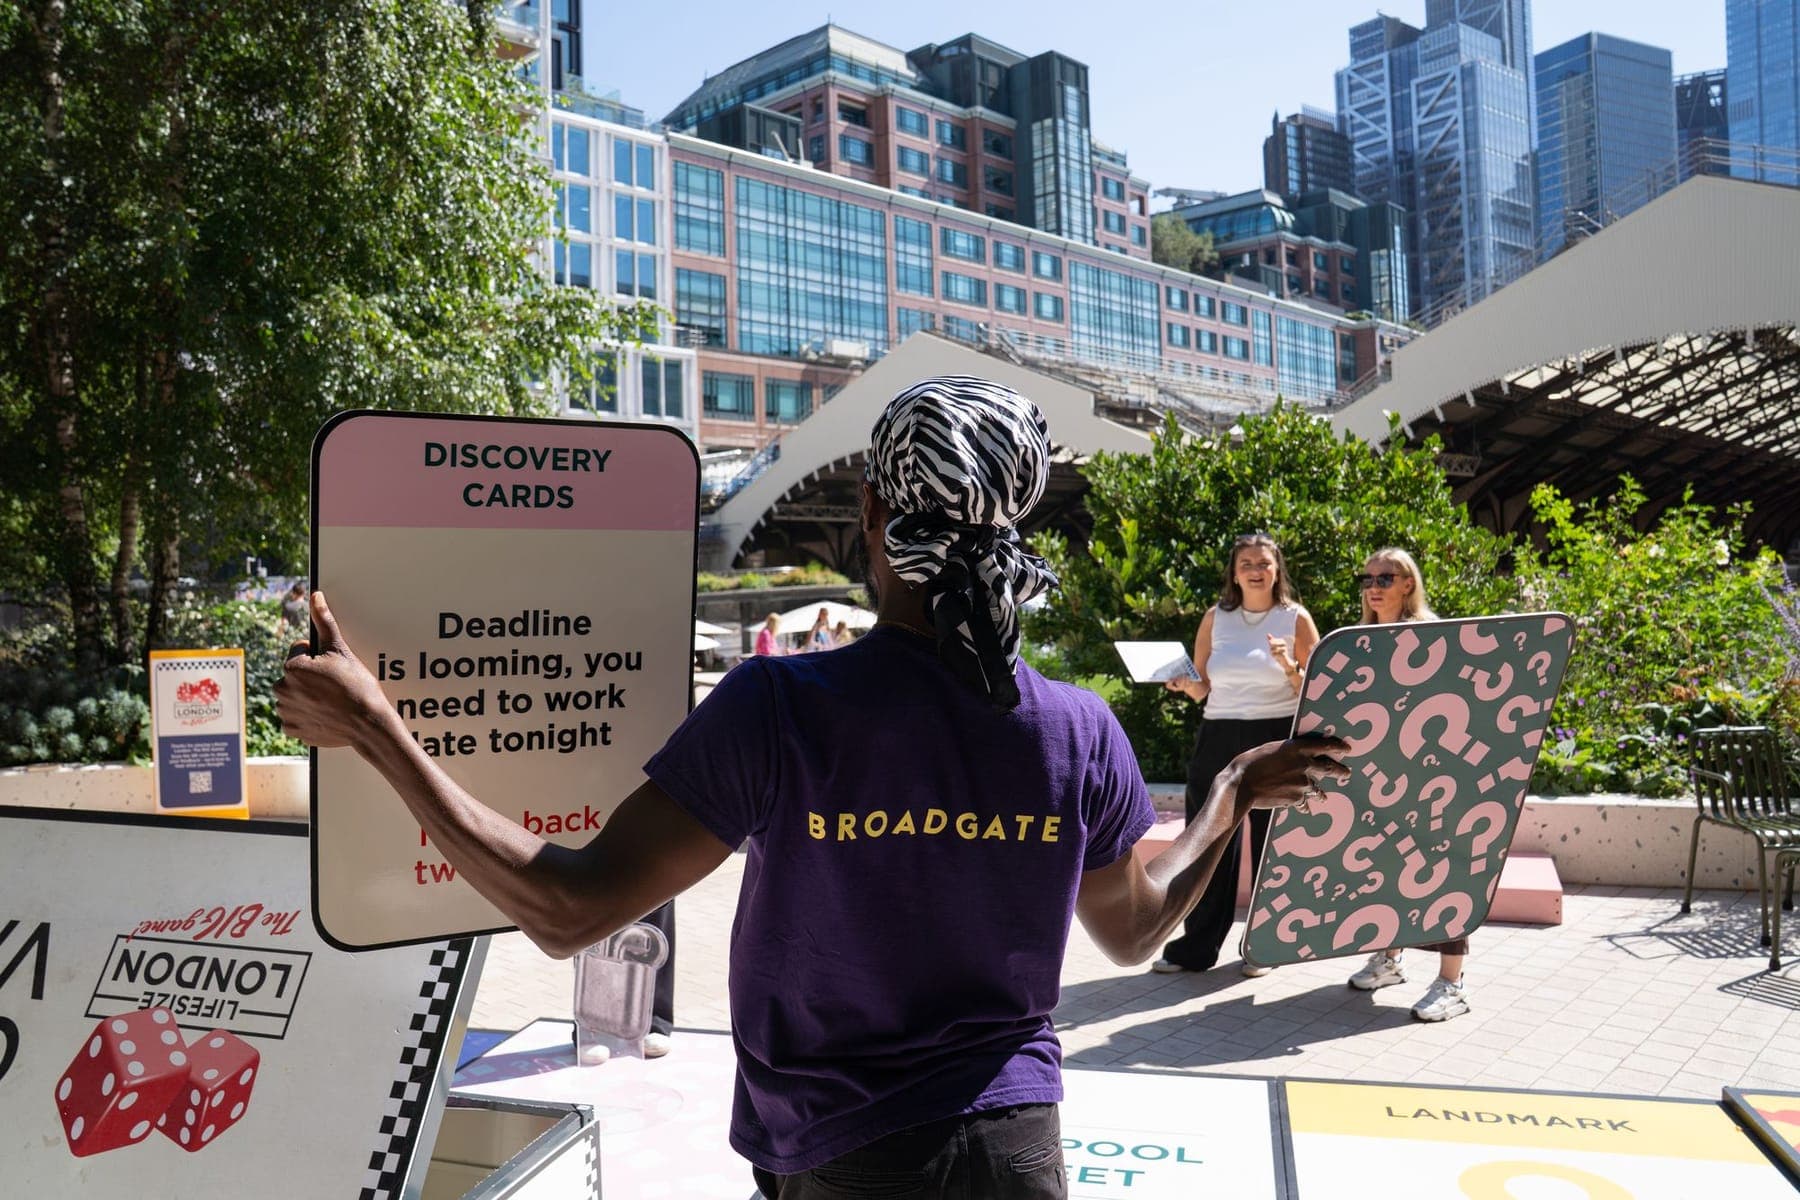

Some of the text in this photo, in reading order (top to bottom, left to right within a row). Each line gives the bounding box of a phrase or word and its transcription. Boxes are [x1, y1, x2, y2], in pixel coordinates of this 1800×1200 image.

[425, 442, 612, 472] DISCOVERY
[463, 483, 574, 509] CARDS
[438, 610, 592, 639] Deadline
[378, 649, 642, 681] is looming, you
[177, 707, 219, 716] LONDON
[397, 683, 626, 720] need to work
[489, 721, 612, 753] tonight
[523, 805, 601, 836] back
[808, 808, 1062, 842] BROADGATE
[414, 860, 456, 885] tw
[126, 903, 301, 943] The BIG game!
[112, 949, 293, 998] LONDON
[138, 991, 240, 1020] LIFESIZE
[1386, 1106, 1638, 1133] LANDMARK
[1060, 1138, 1203, 1164] POOL
